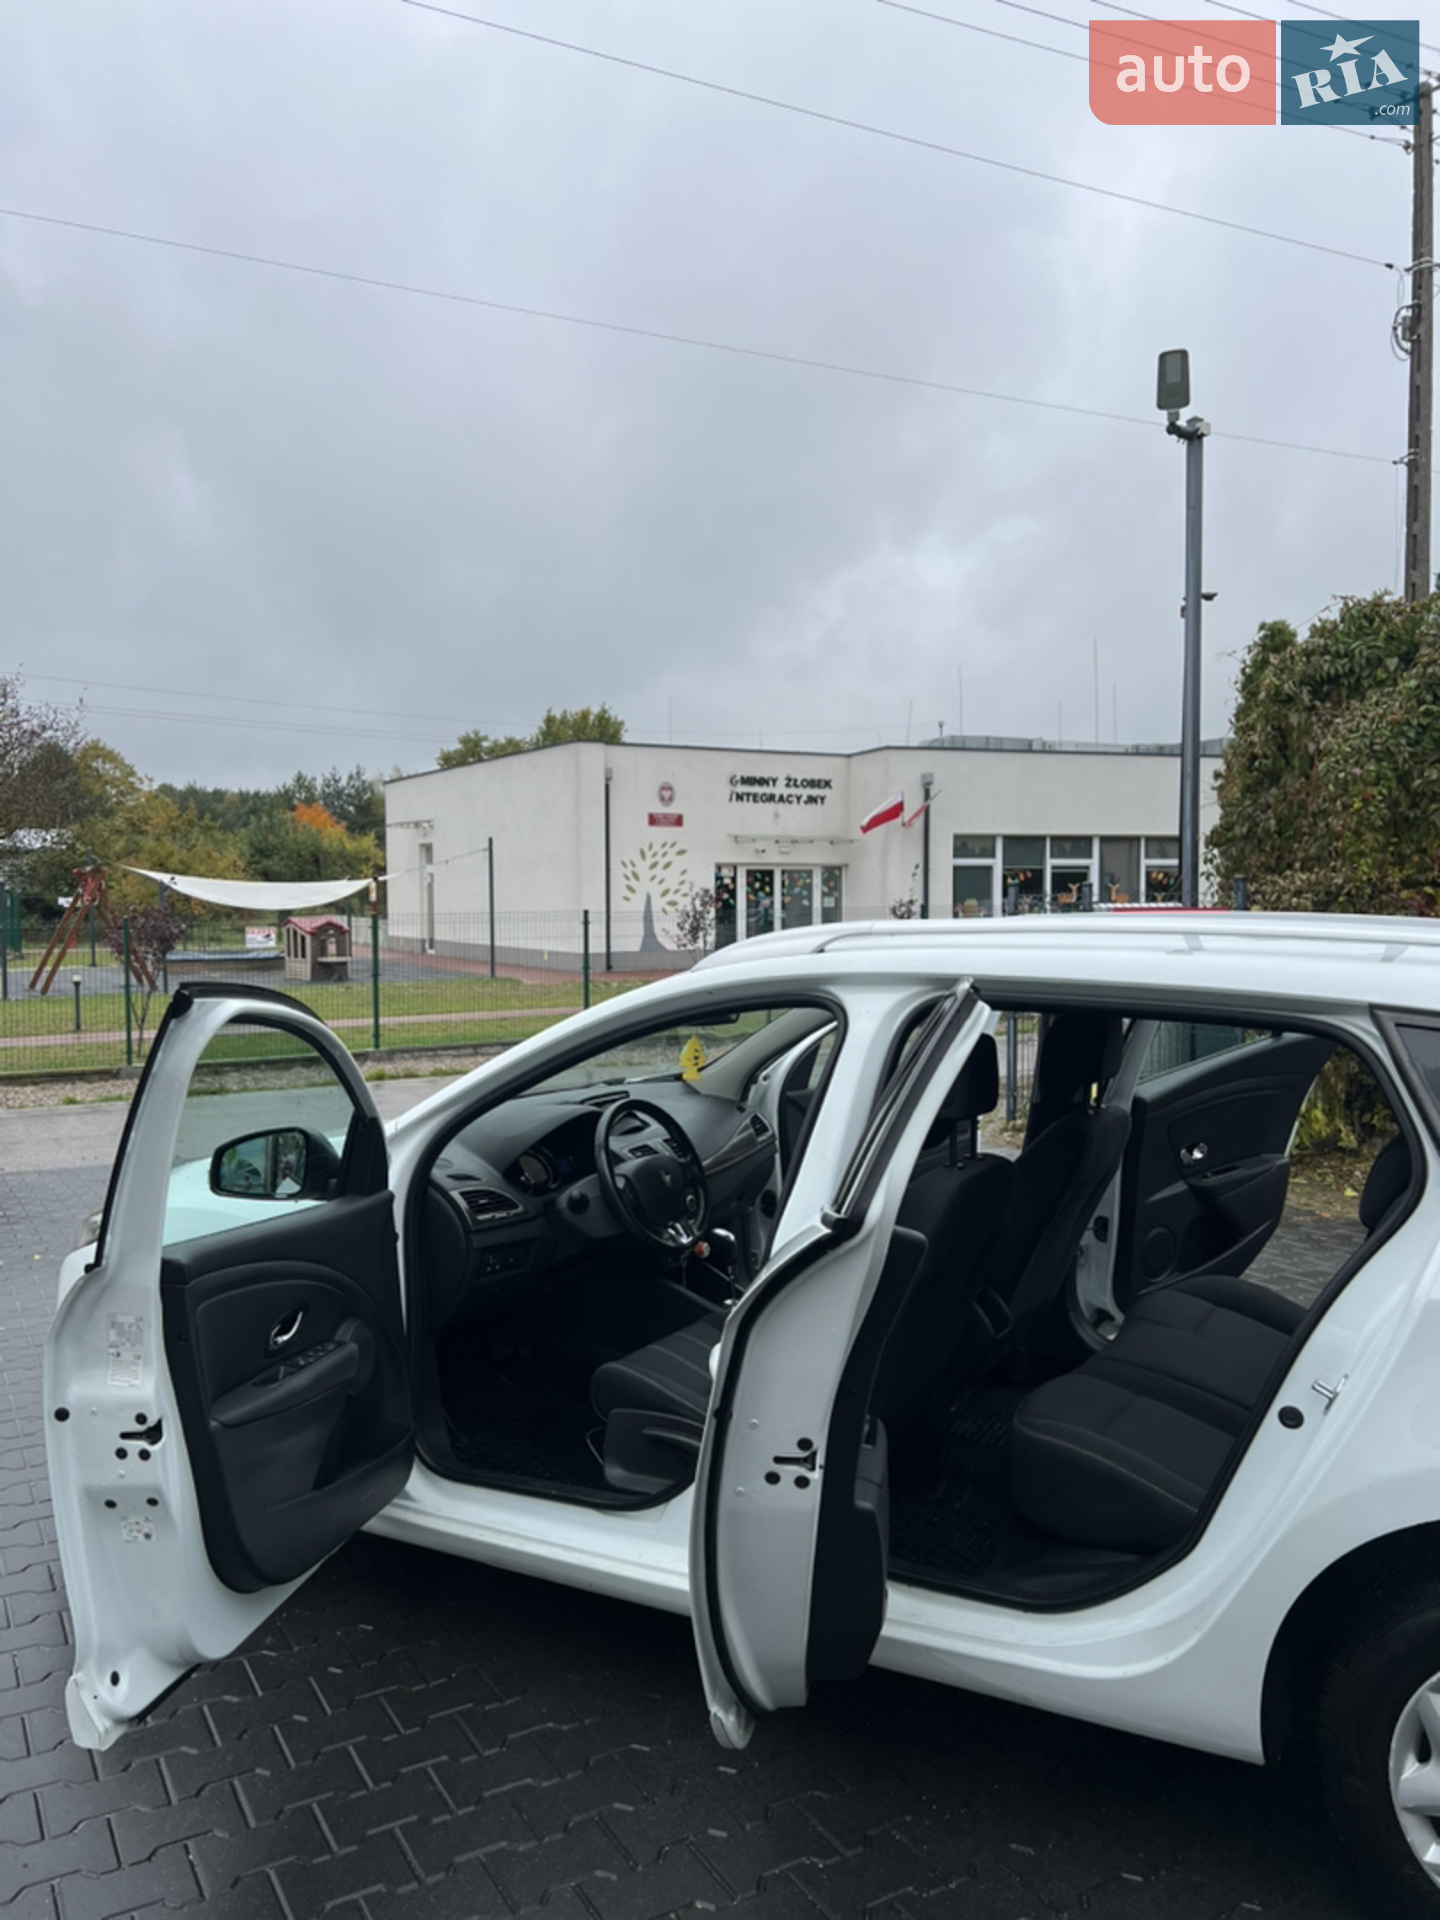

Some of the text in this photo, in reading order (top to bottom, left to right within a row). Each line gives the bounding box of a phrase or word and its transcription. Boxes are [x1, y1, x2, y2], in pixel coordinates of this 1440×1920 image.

[729, 773, 833, 790] GMINNY ŻŁOBEK
[728, 789, 827, 806] INTEGRACYJNY
